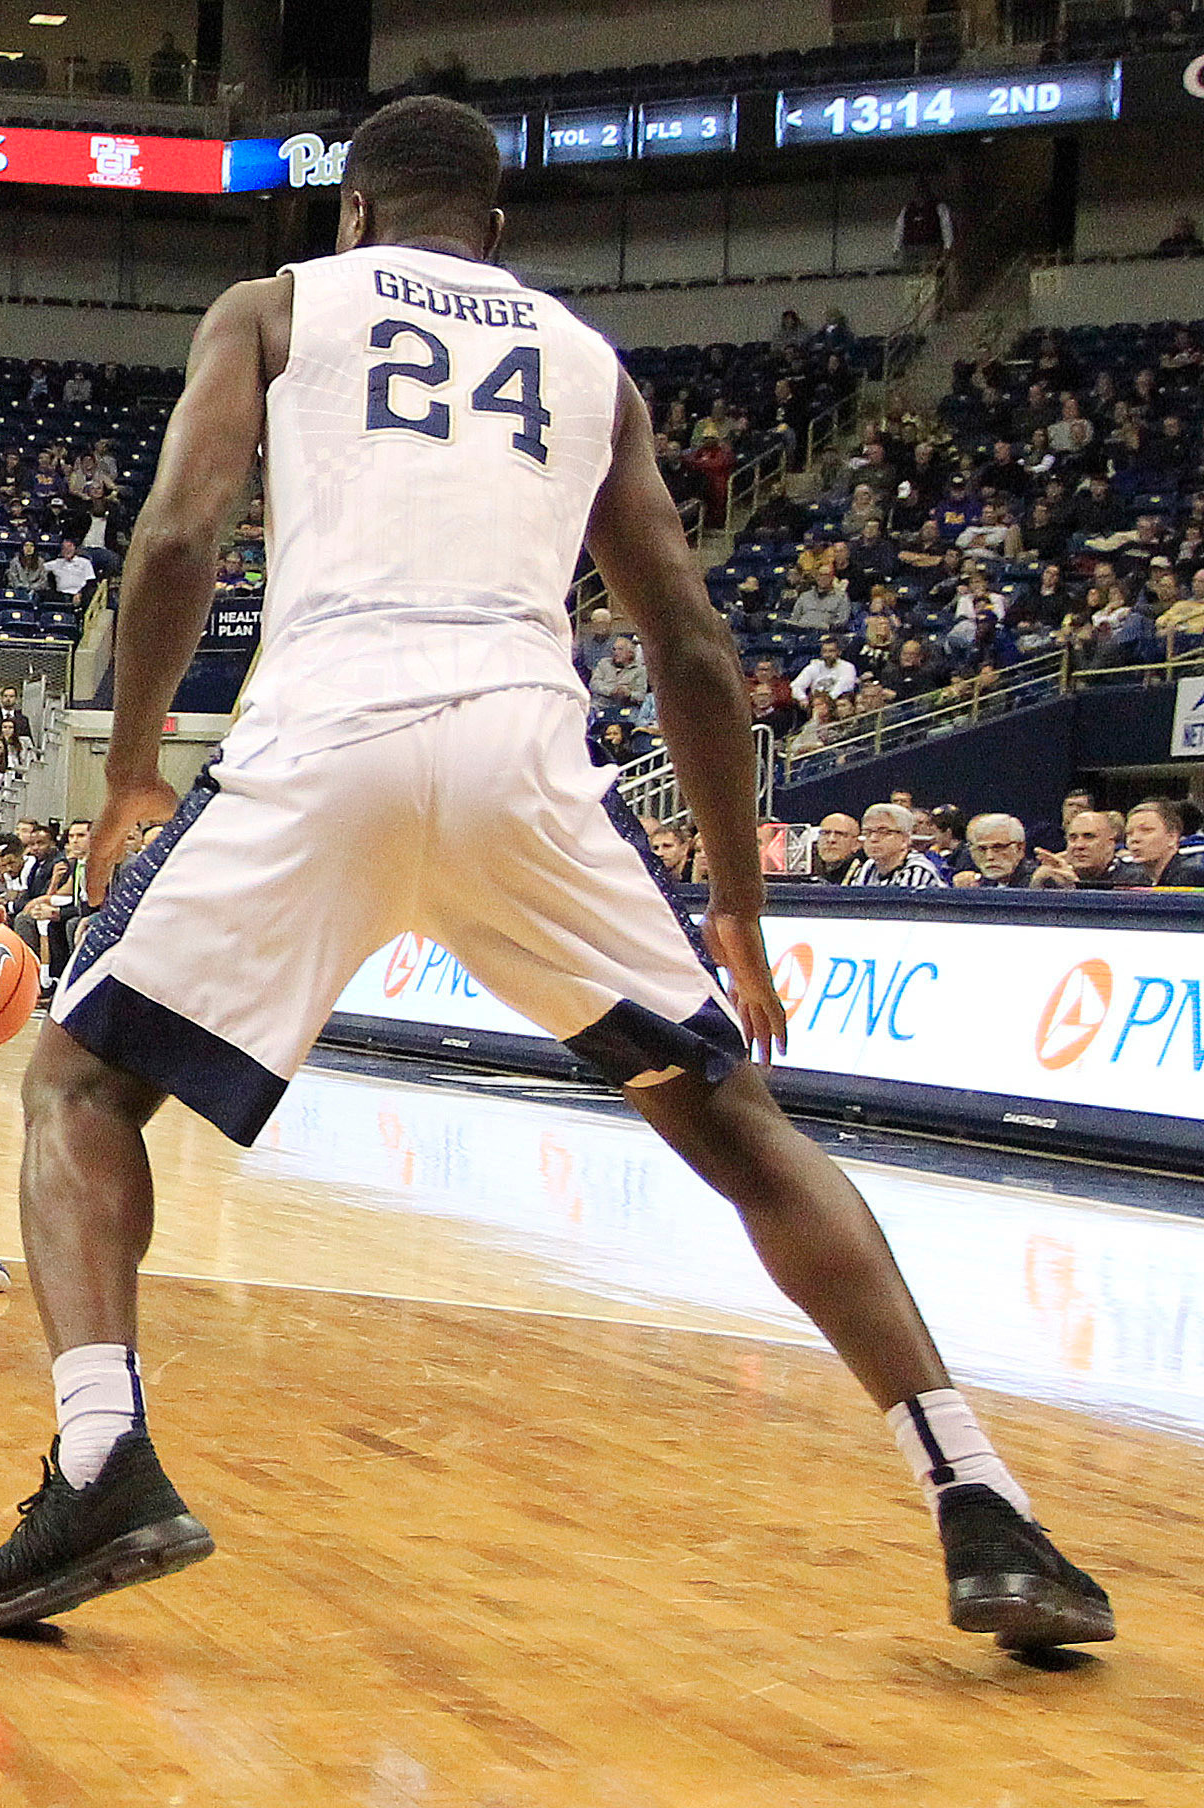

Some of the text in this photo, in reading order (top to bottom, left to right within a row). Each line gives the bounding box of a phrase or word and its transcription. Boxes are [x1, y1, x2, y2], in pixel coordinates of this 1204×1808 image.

[823, 82, 1062, 135] 13:14 2ND
[551, 124, 619, 147] TOL 2
[646, 116, 717, 140] FLS 3
[374, 270, 538, 331] GEORGE
[364, 317, 553, 466] 24
[218, 611, 261, 623] HEALT
[218, 624, 254, 637] PLAN
[807, 956, 939, 1041] PNC
